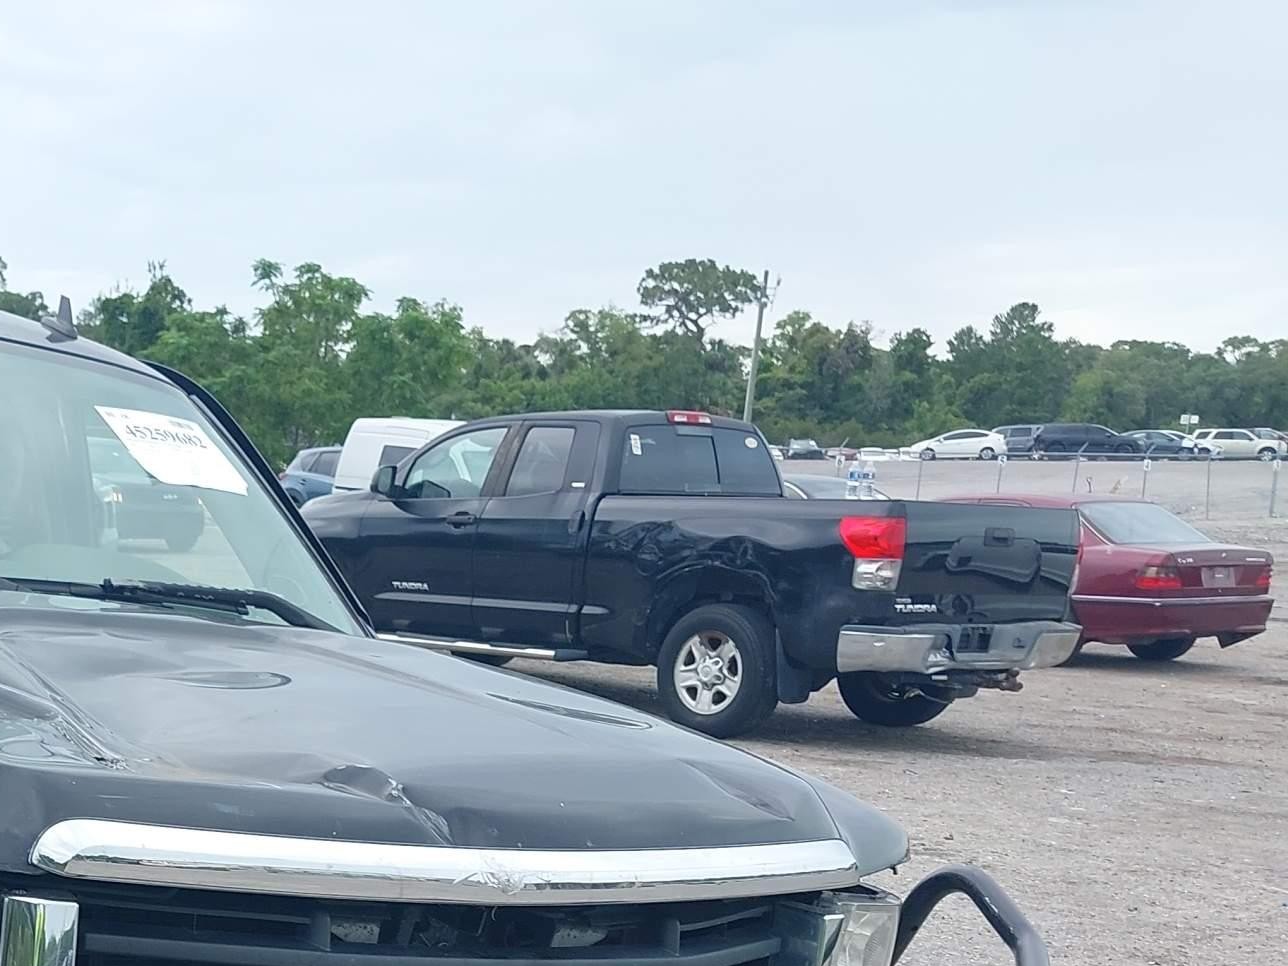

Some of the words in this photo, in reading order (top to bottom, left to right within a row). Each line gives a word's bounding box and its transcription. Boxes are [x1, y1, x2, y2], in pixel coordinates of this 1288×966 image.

[125, 424, 208, 449] 45259682
[391, 581, 430, 591] TUNDRA
[894, 604, 938, 613] TUNDRA
